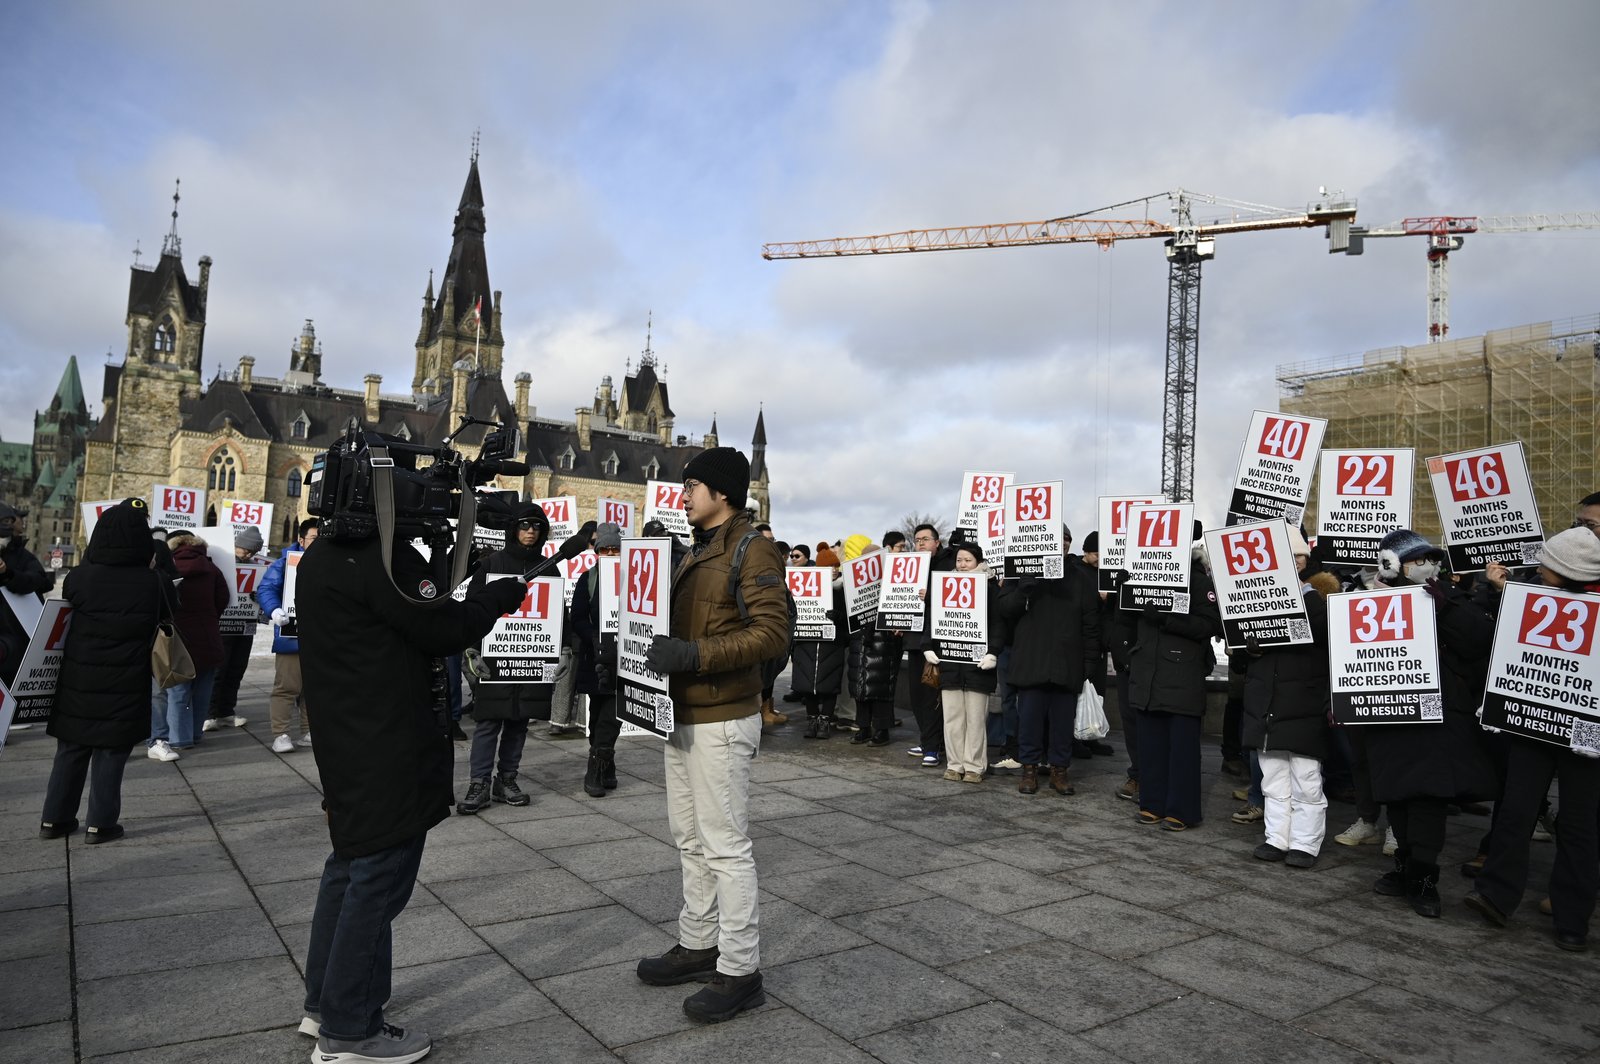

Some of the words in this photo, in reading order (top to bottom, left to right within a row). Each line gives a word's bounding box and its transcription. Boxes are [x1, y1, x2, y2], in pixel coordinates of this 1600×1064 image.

[1264, 420, 1303, 458] 40
[1259, 459, 1293, 472] MONTHS
[1248, 468, 1281, 482] WAITING
[1283, 475, 1300, 486] FOR
[1342, 456, 1387, 494] 22
[1455, 455, 1501, 498] 46
[973, 477, 1000, 502] 38
[1241, 477, 1258, 488] IRCC
[1259, 481, 1303, 497] RESPONSE
[167, 490, 191, 513] 19
[658, 487, 682, 508] 27
[1020, 488, 1047, 520] 53
[1245, 494, 1255, 503] NO
[1255, 497, 1286, 509] TIMELINE
[545, 501, 565, 521] 27
[1246, 503, 1255, 512] NO
[1342, 500, 1385, 510] MONTHS
[1462, 500, 1508, 515] MONTHS
[234, 504, 259, 524] 35
[609, 504, 625, 527] 19
[1330, 512, 1373, 521] WAITING
[1376, 513, 1396, 522] FOR
[1454, 514, 1498, 528] WAITING
[1501, 511, 1523, 522] FOR
[991, 510, 1004, 535] 4
[1019, 525, 1046, 533] MONTHS
[1145, 511, 1172, 546] 71
[1324, 523, 1345, 532] IRCC
[1451, 530, 1474, 541] IRCC
[1476, 522, 1533, 538] RESPONSE
[1012, 535, 1038, 543] WAITING
[1346, 540, 1380, 548] TIMELIN
[1023, 543, 1058, 552] RESPONSE
[1229, 530, 1271, 573] 53
[1465, 546, 1477, 555] NO
[1141, 551, 1172, 560] MONTHS
[1350, 550, 1380, 559] RESULT
[1471, 556, 1483, 564] NO
[1485, 552, 1523, 563] RESULTS
[856, 557, 879, 585] 30
[894, 558, 917, 583] 30
[1132, 562, 1162, 570] WAITING
[1165, 563, 1180, 571] FOR
[630, 550, 654, 613] 32
[1144, 573, 1183, 582] RESPONSE
[1235, 576, 1275, 589] MONTHS
[792, 573, 818, 596] 34
[853, 591, 876, 604] WAITING
[945, 577, 971, 608] 28
[1133, 588, 1141, 596] NO
[1228, 589, 1266, 602] WAITING
[1269, 587, 1289, 597] FOR
[1135, 597, 1143, 605] NO
[1225, 604, 1246, 615] IRCC
[1247, 599, 1297, 613] RESPONSE
[851, 604, 863, 613] IRCC
[945, 611, 971, 619] MONTHS
[938, 620, 963, 628] WAITING
[1356, 595, 1407, 641] 34
[1525, 596, 1589, 651] 23
[505, 623, 542, 631] MONTHS
[629, 621, 653, 639] MONTHS
[1238, 622, 1249, 630] NO
[495, 634, 531, 642] WAITING
[535, 634, 551, 642] FOR
[949, 630, 982, 638] RESPONSE
[1257, 629, 1289, 639] RESULTS
[489, 644, 508, 652] IRCC
[510, 645, 555, 653] RESPONSE
[624, 639, 646, 657] WAITING
[950, 650, 972, 658] RESULTS
[1357, 647, 1407, 659] MONTHS
[620, 656, 631, 672] IRCC
[1345, 661, 1394, 673] WAITING
[1398, 660, 1422, 670] FOR
[1521, 651, 1579, 673] MONTHS
[29, 669, 58, 678] WAITIN
[1339, 677, 1364, 687] IRCC
[1366, 673, 1430, 685] RESPONSE
[1506, 664, 1561, 685] WAITING
[1564, 676, 1593, 692] FOR
[18, 682, 39, 691] IRCC
[1495, 677, 1523, 693] IRCC
[1525, 684, 1599, 709] RESPONSE
[624, 685, 630, 697] NO
[631, 687, 656, 706] TIMELINES
[1351, 696, 1364, 705] NO
[1366, 694, 1418, 704] TIMELINES
[20, 699, 31, 708] NO
[1504, 701, 1520, 713] NO
[18, 710, 30, 718] NO
[626, 701, 632, 713] NO
[633, 704, 654, 722] RESULTS
[1355, 707, 1369, 716] NO
[1372, 706, 1415, 715] RESULTS
[1506, 714, 1522, 726] NO
[1524, 717, 1572, 738] RESULTS
